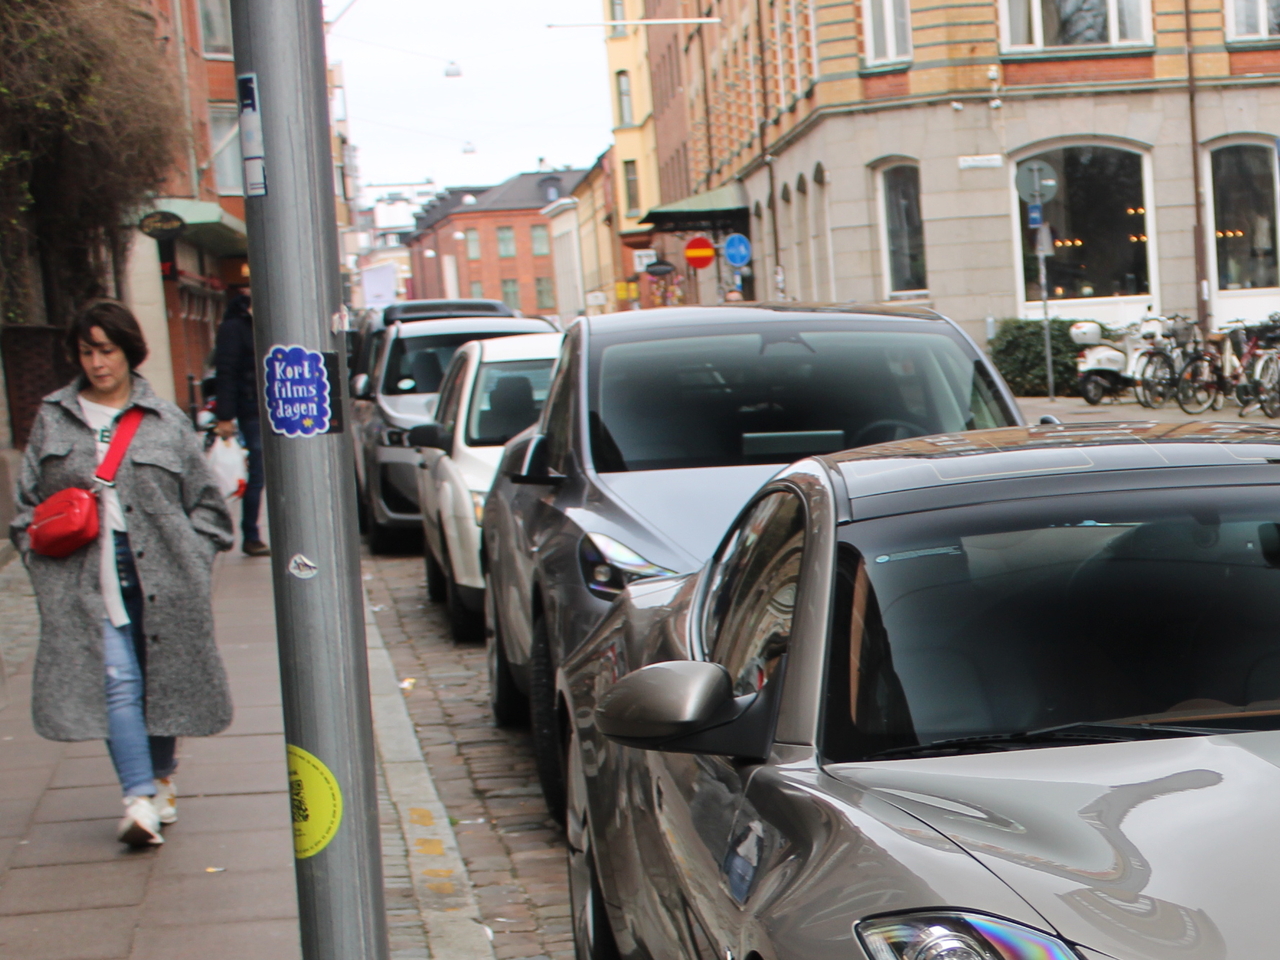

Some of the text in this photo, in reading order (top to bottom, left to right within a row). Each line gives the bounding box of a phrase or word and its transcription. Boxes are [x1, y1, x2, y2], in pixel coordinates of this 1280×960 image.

[274, 361, 312, 380] Kort
[274, 380, 317, 398] films
[276, 399, 318, 421] dagen
